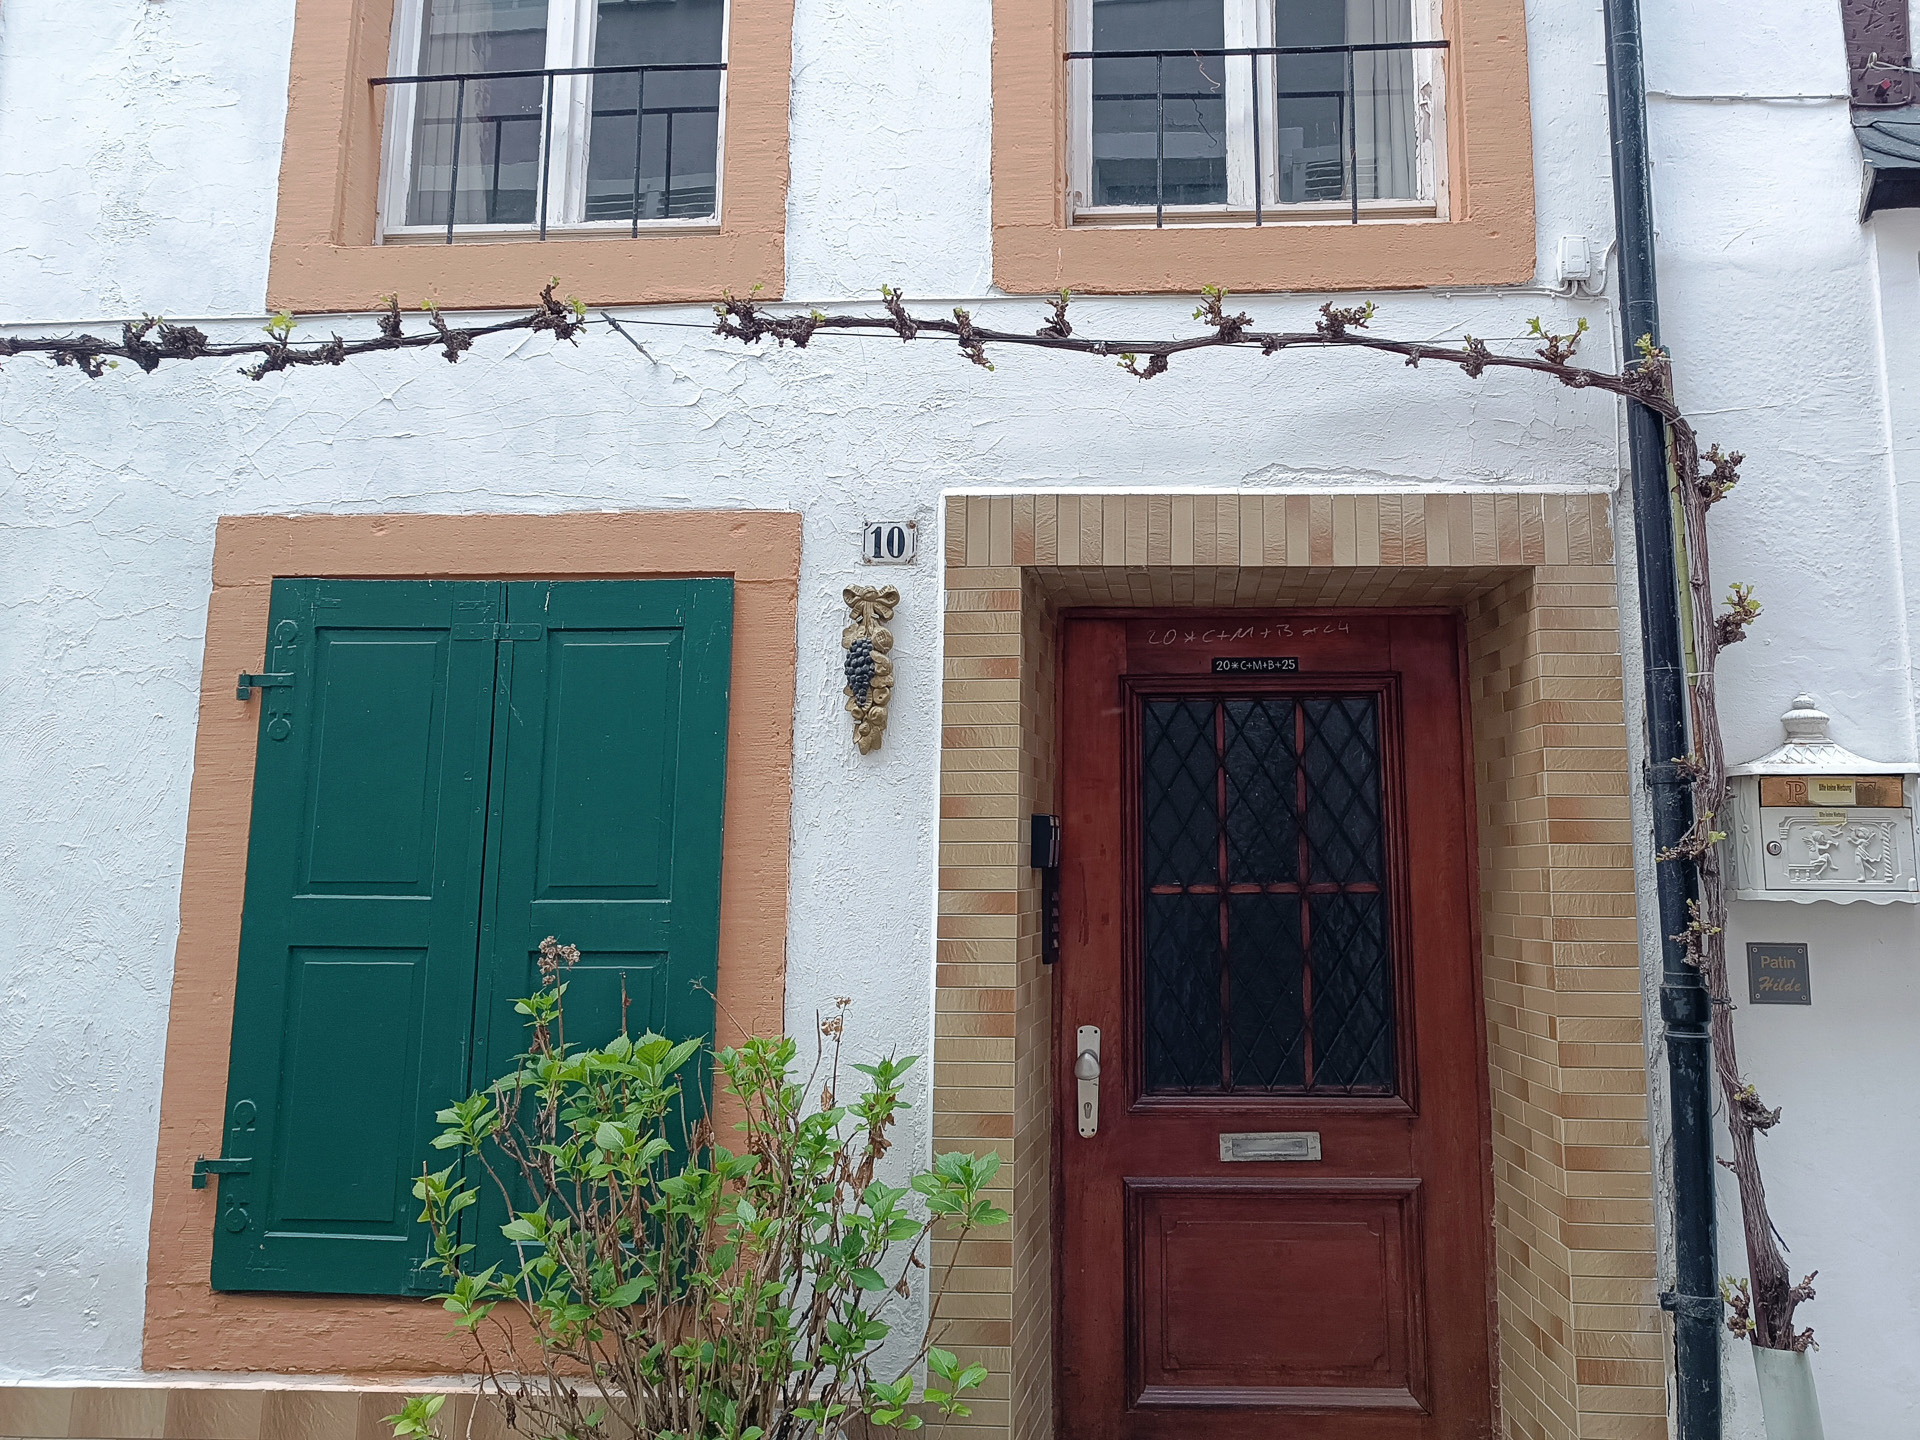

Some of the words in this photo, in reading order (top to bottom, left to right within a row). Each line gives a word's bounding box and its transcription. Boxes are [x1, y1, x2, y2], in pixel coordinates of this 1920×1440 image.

[870, 526, 906, 559] 10
[1760, 955, 1796, 969] Patin
[1758, 975, 1802, 992] Hilde
